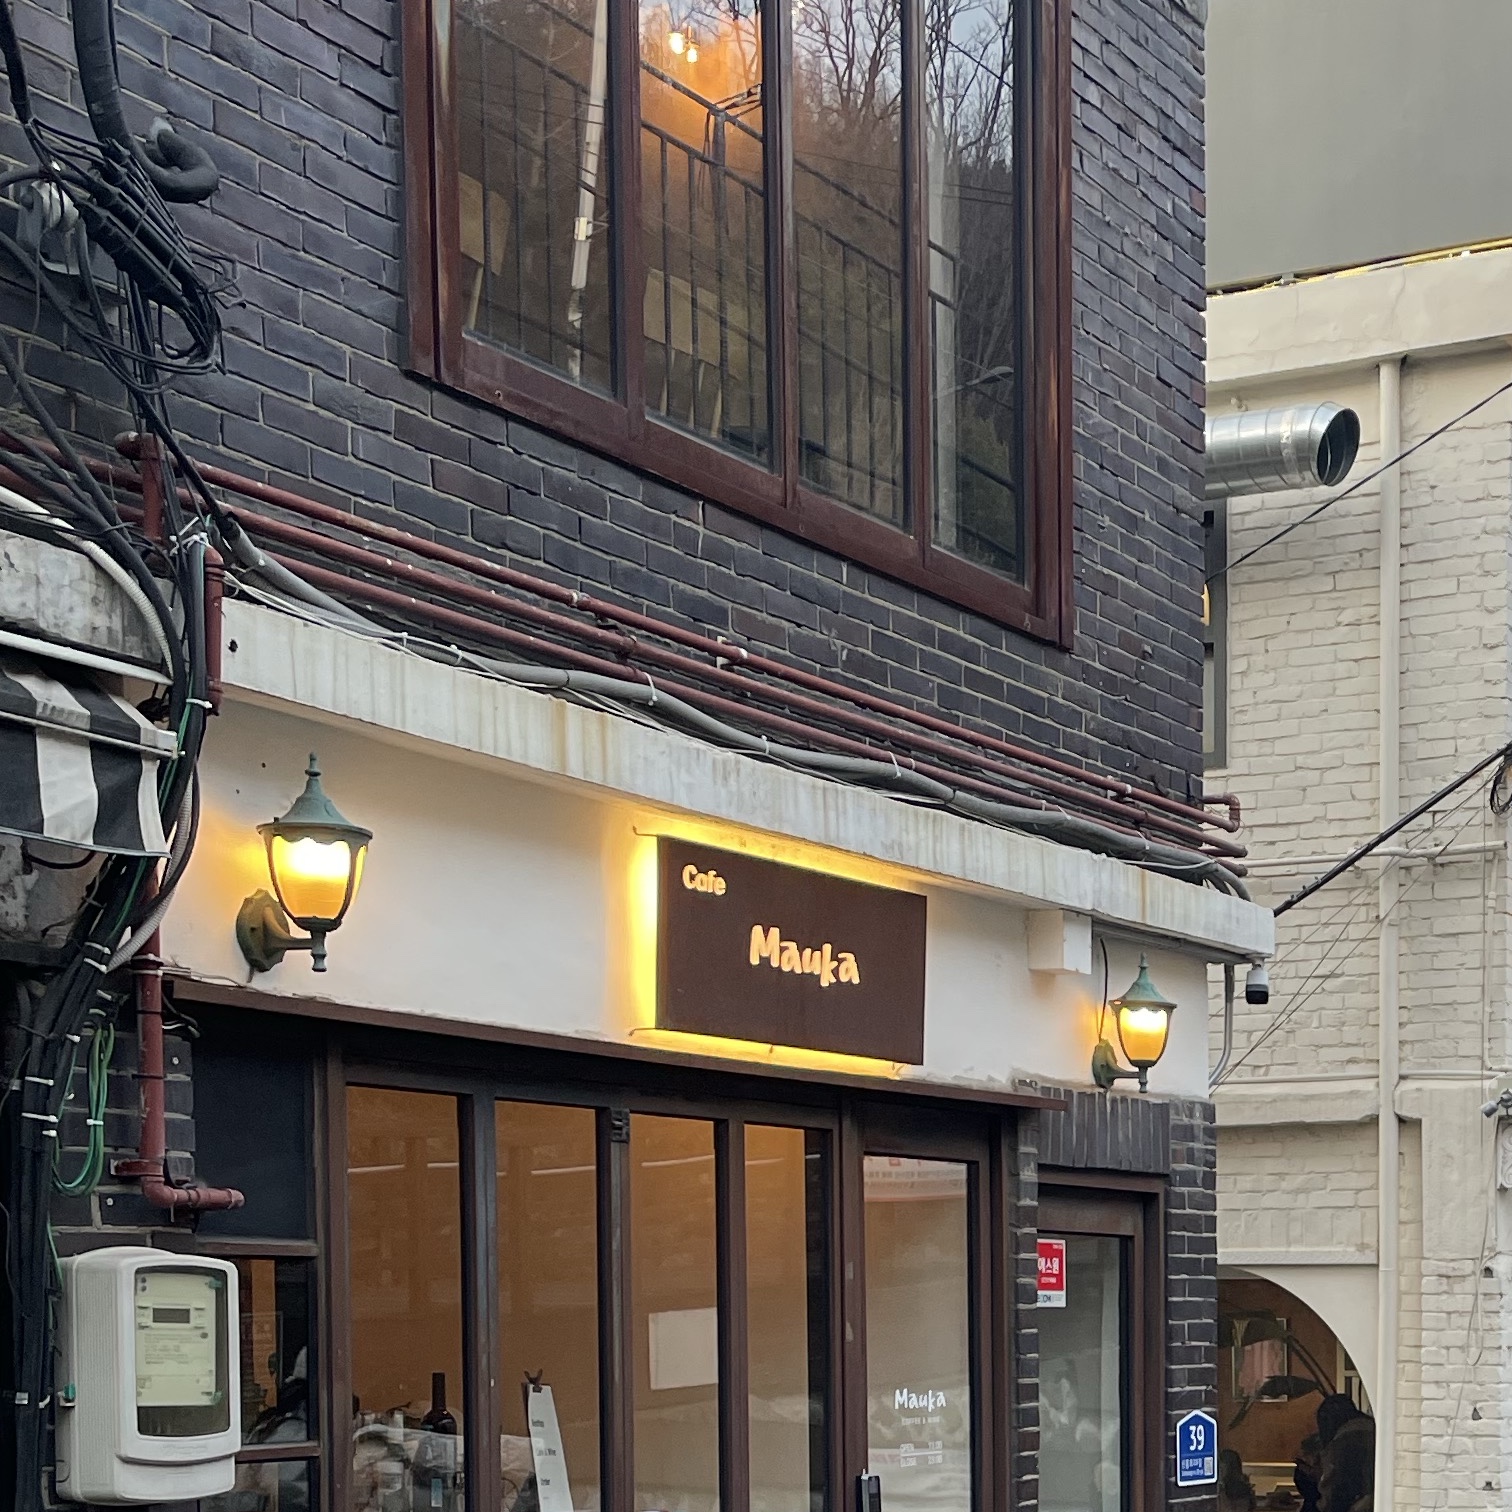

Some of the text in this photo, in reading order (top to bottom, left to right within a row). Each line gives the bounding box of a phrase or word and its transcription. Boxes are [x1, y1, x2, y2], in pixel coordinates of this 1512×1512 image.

[681, 864, 727, 896] Cafe
[749, 924, 860, 988] Mauka
[895, 1388, 946, 1412] Mauka
[1189, 1424, 1205, 1451] 39
